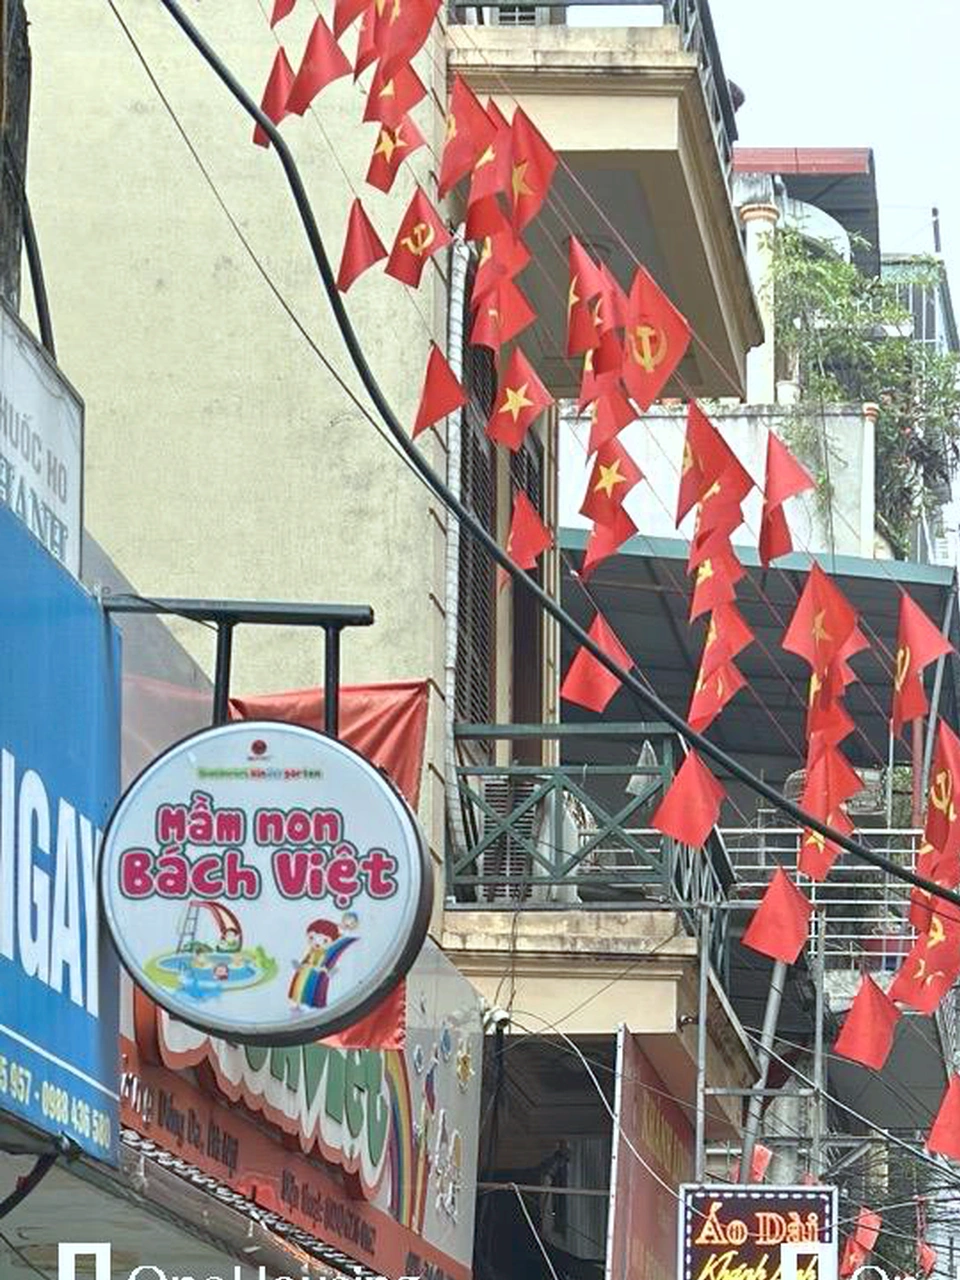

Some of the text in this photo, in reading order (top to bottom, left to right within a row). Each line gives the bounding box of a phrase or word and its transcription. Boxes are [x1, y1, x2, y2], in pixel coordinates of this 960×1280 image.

[157, 793, 342, 845] Mầm non
[119, 839, 399, 908] Bách Việt
[695, 1201, 748, 1245] Áo
